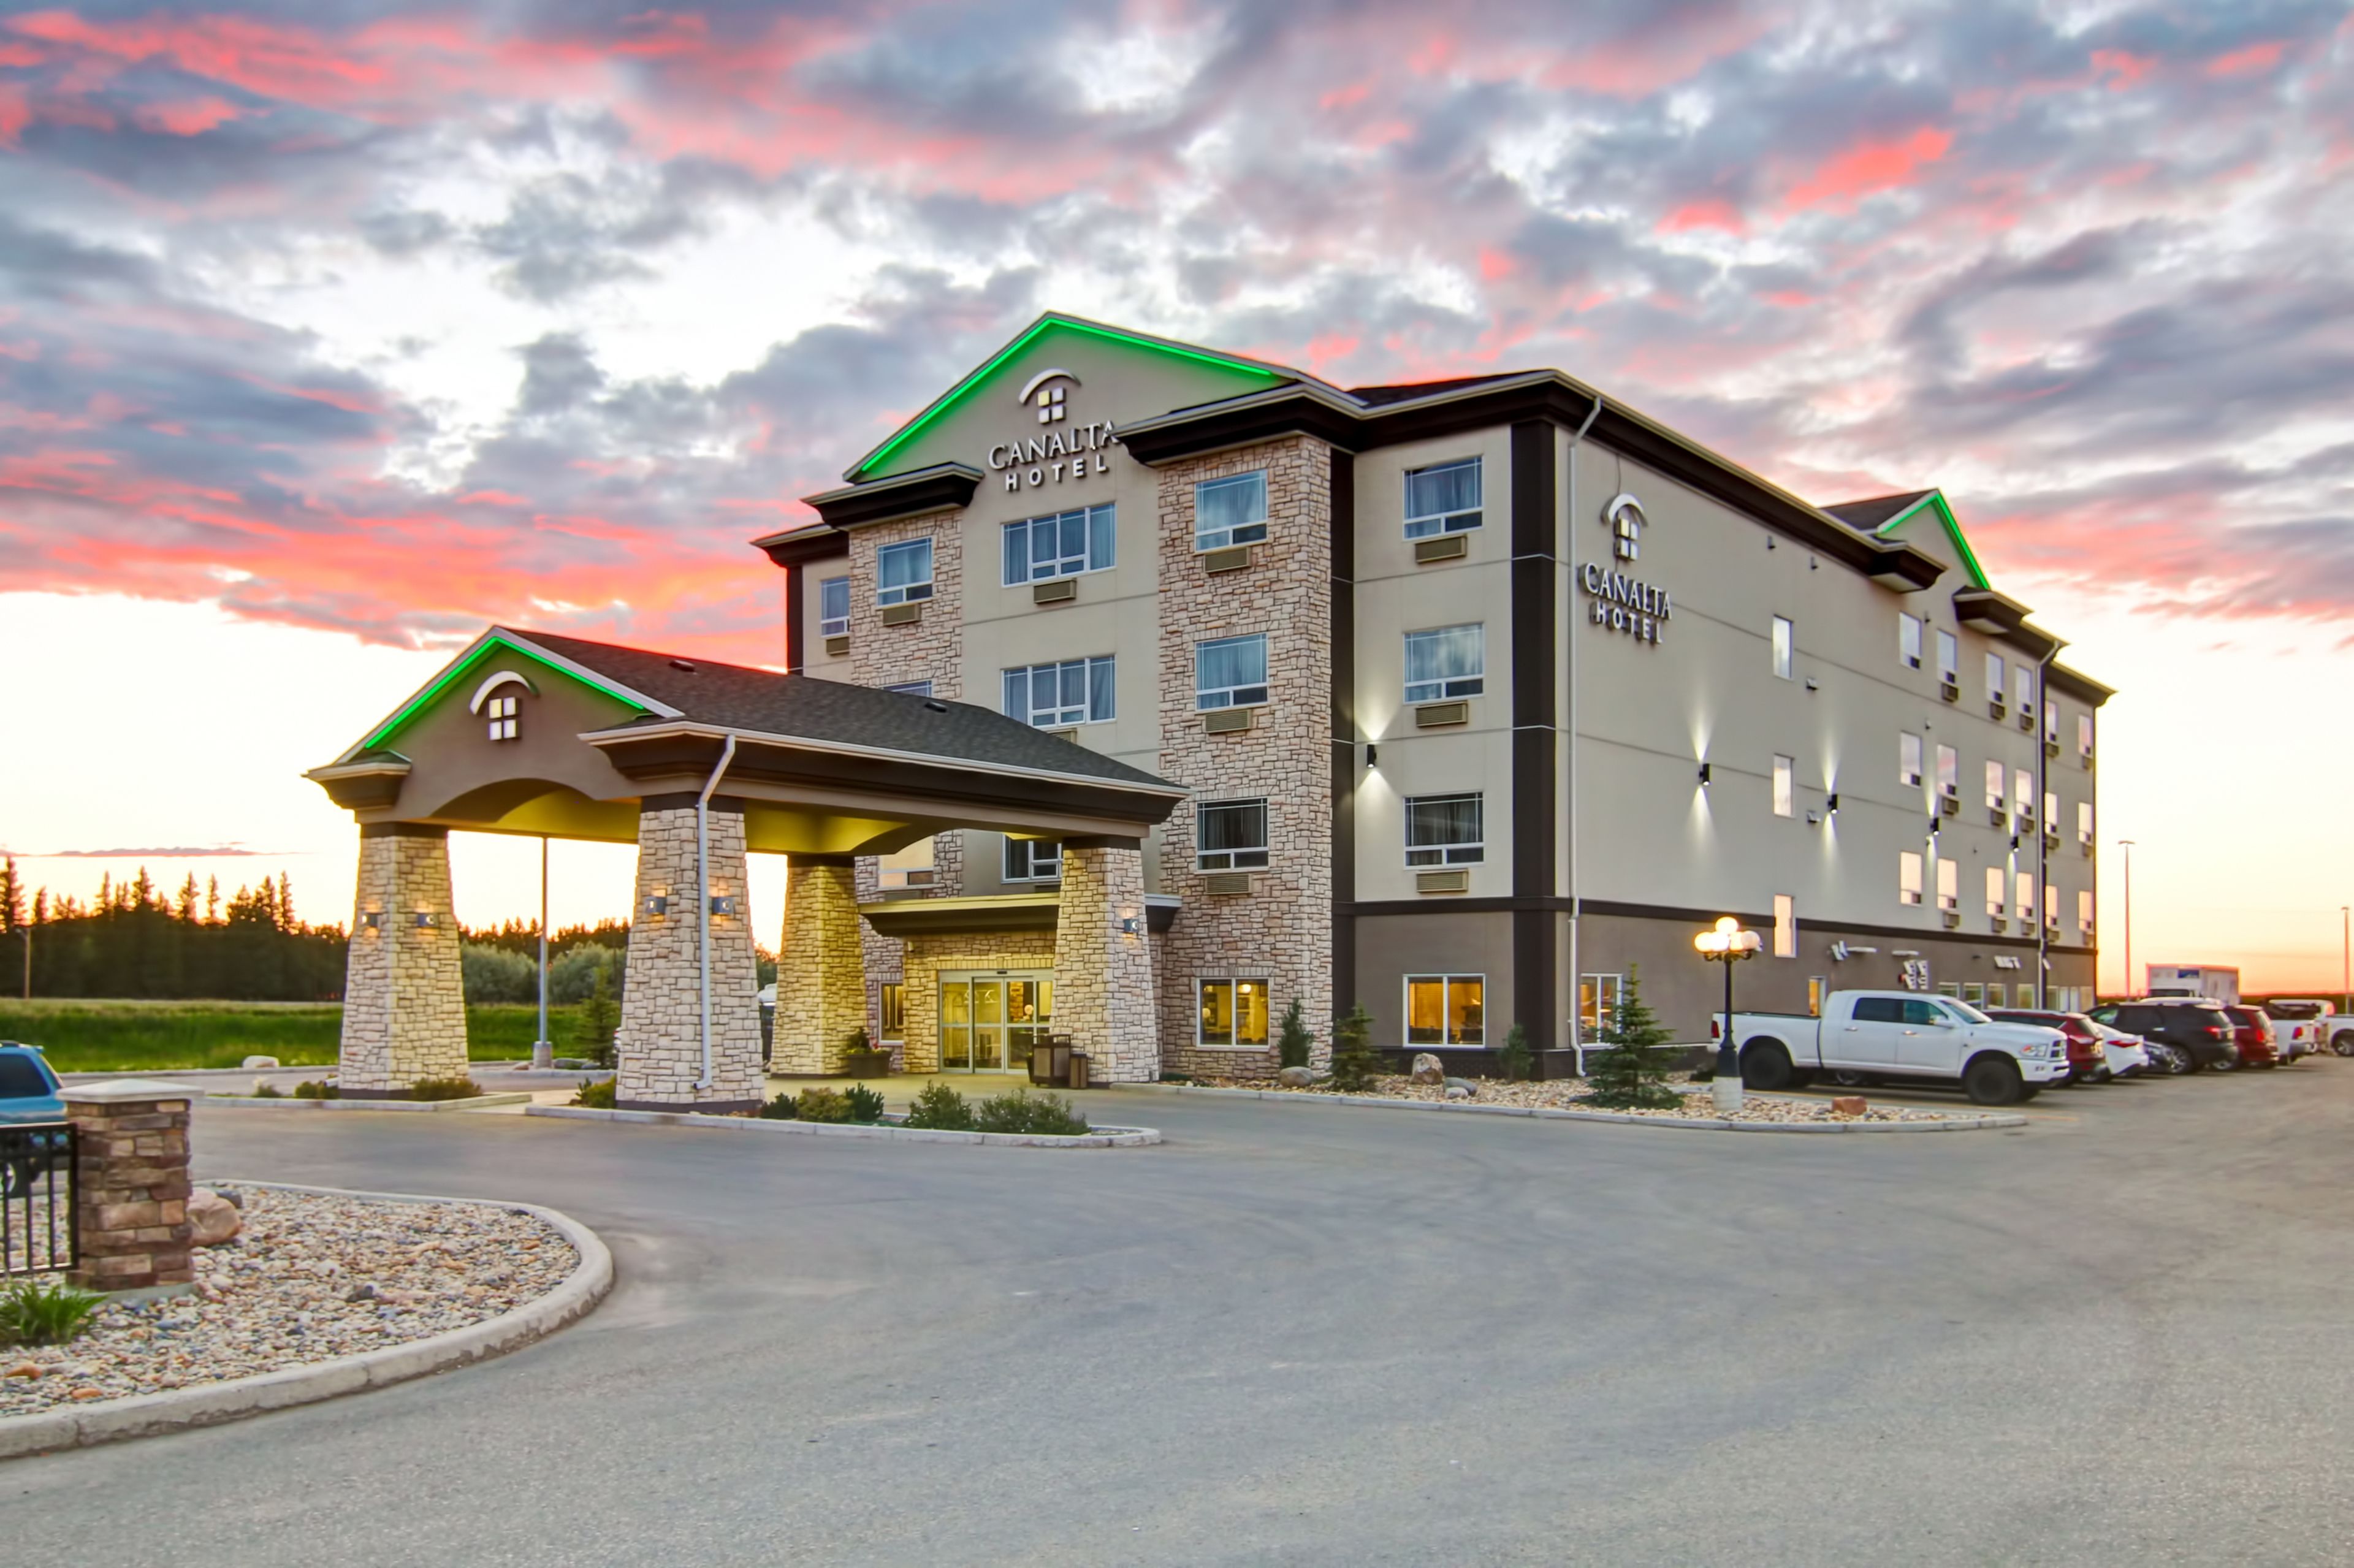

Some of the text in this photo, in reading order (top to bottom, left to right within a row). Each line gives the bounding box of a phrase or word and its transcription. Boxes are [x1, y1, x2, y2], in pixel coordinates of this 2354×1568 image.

[988, 420, 1120, 470] CANALTA
[1005, 454, 1108, 492] HOTEL
[1582, 561, 1673, 620] CANALTA
[1593, 600, 1664, 644] HOTEL
